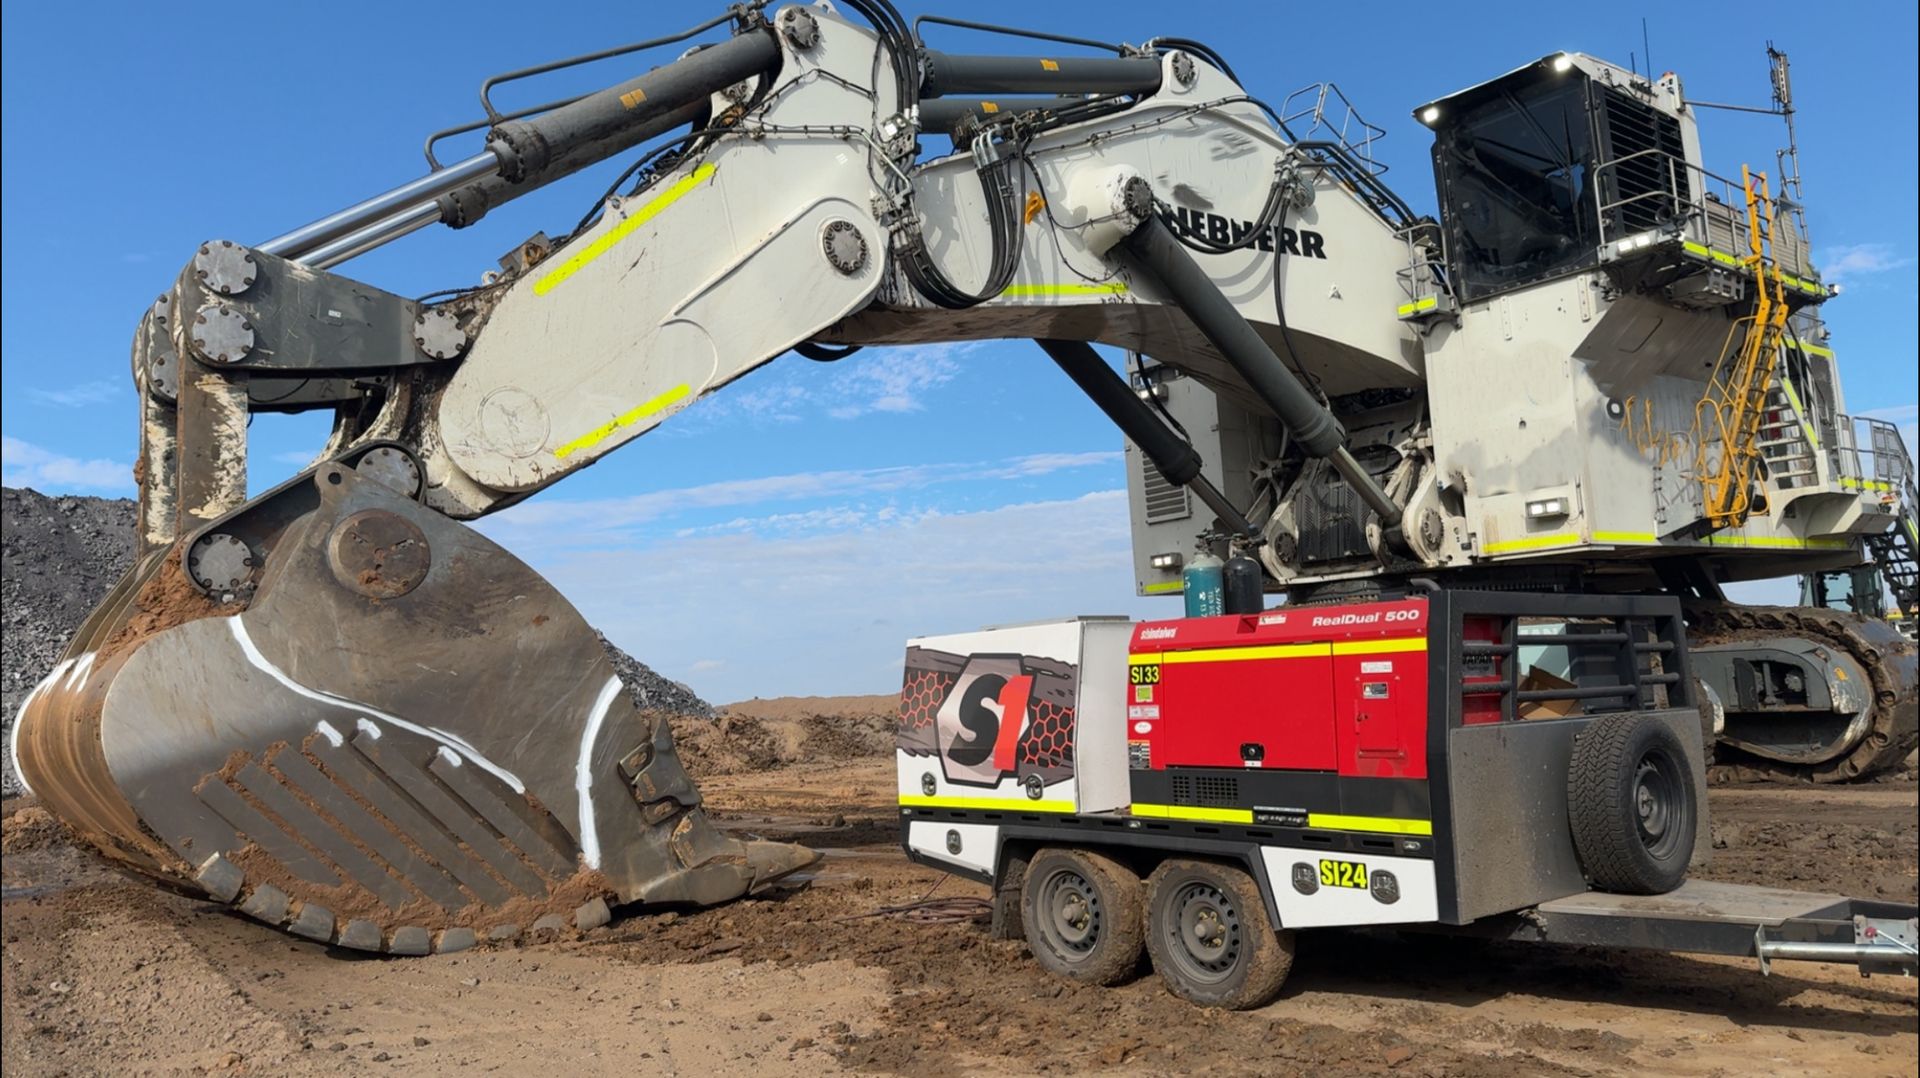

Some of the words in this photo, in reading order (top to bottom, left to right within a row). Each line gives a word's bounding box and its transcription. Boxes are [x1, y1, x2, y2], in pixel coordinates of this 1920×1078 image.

[1312, 612, 1380, 627] RealDual
[1385, 609, 1420, 622] 500
[1321, 860, 1367, 888] SI24
